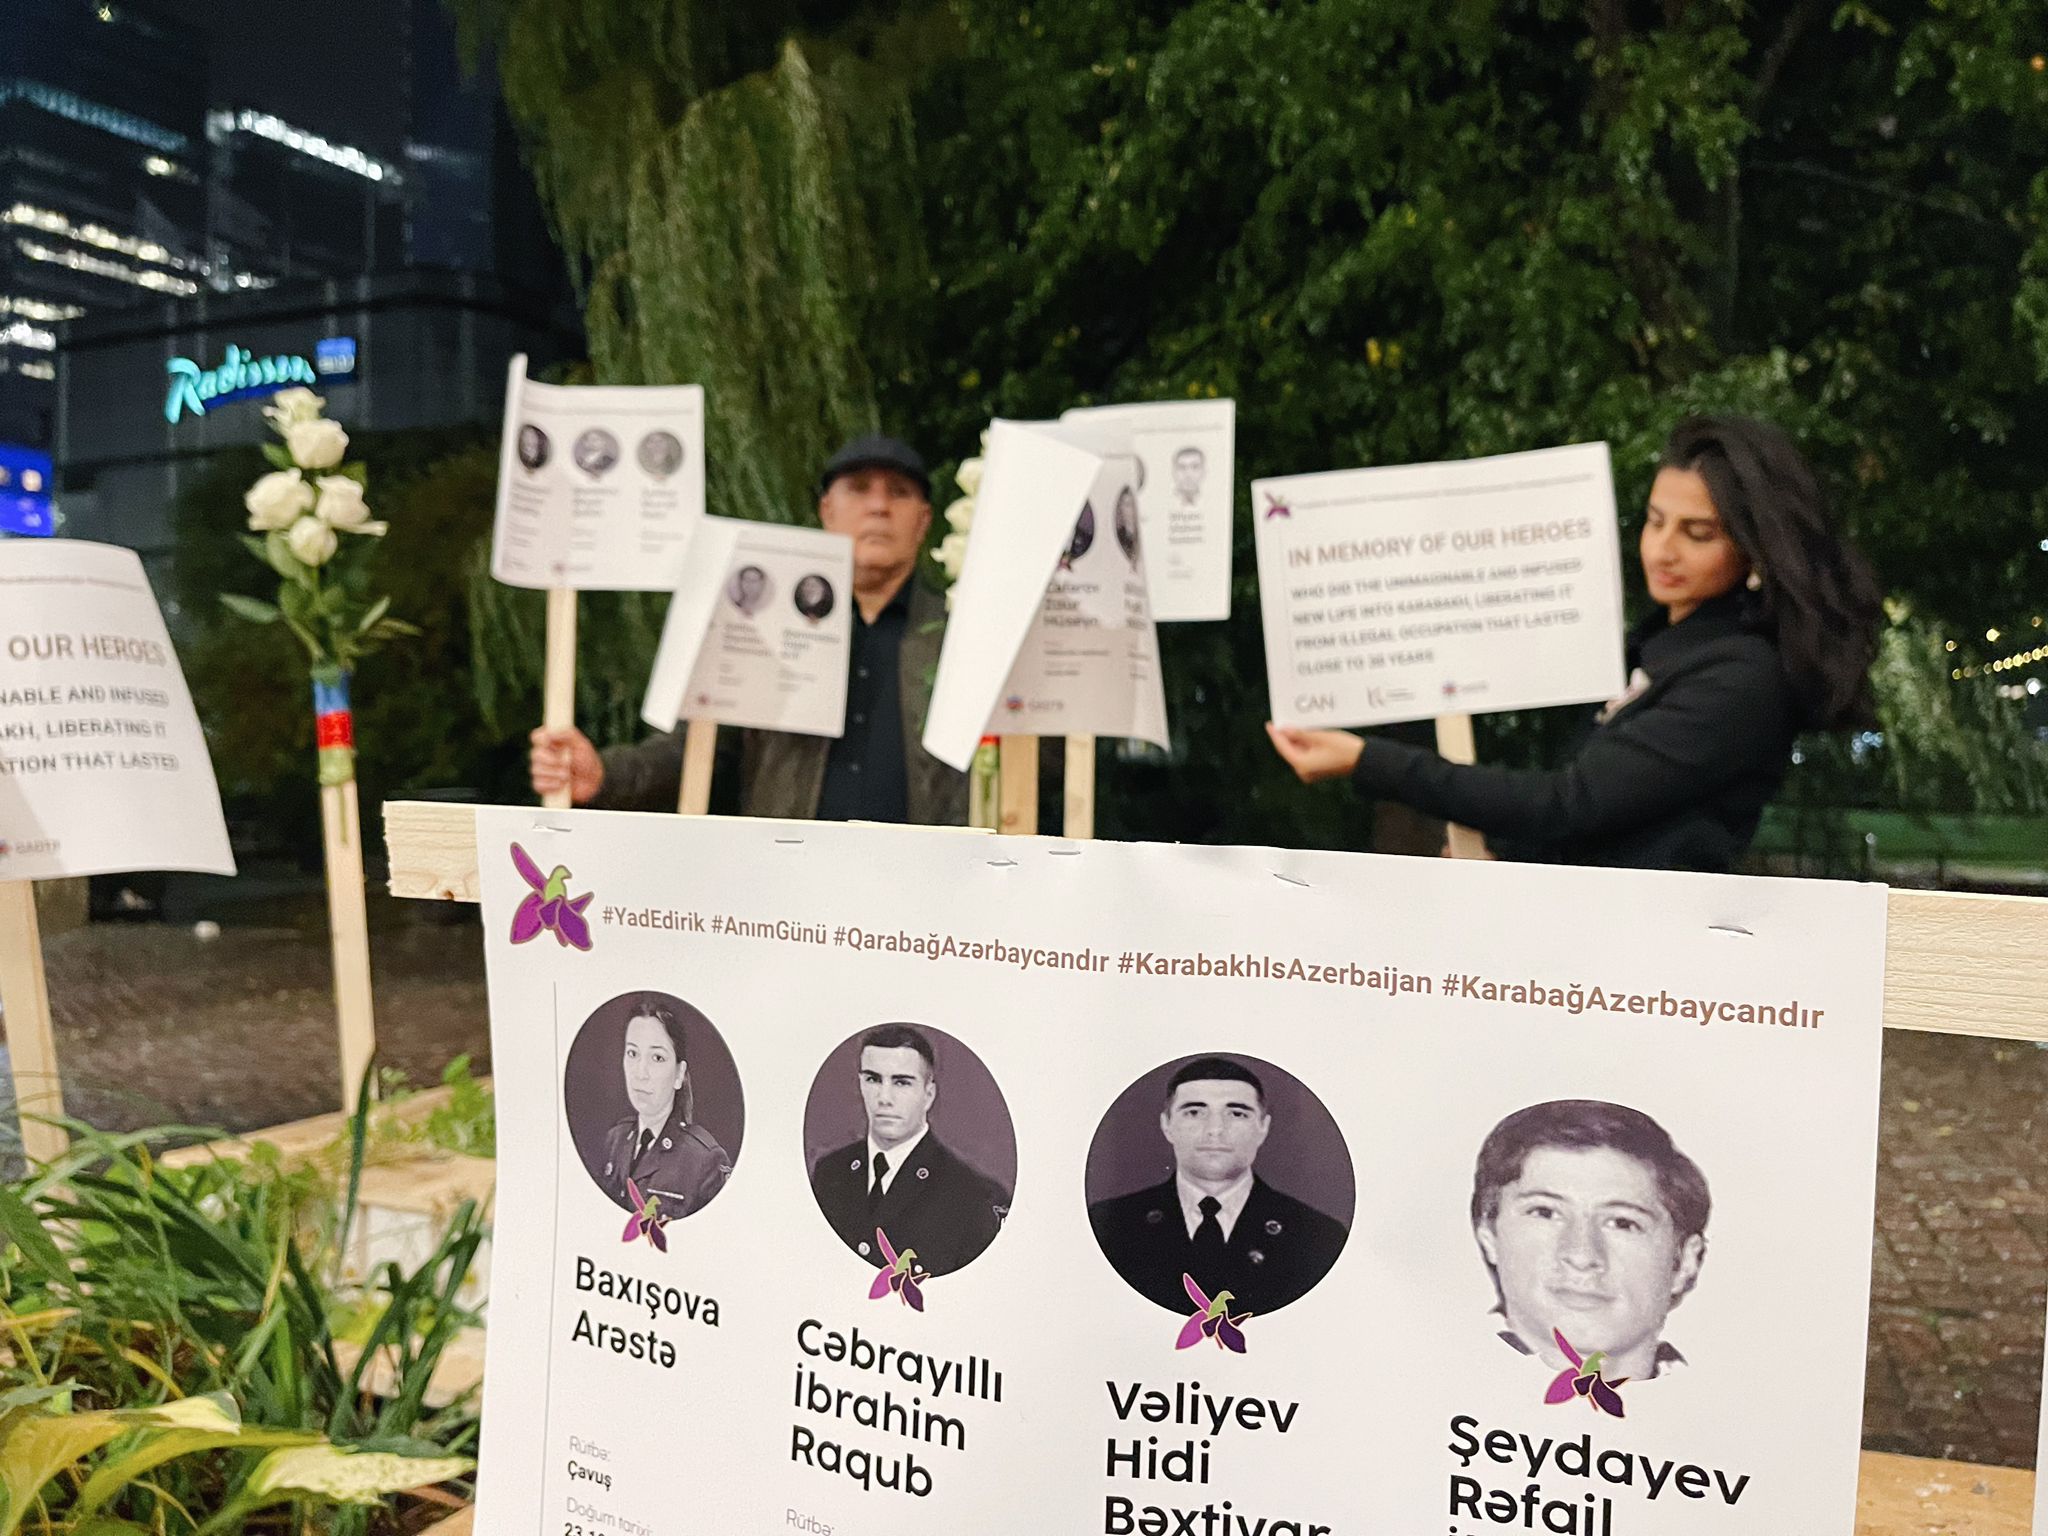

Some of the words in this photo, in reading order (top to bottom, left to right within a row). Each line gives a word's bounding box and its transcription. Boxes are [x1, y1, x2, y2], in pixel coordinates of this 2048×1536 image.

[1288, 547, 1311, 568] IN
[1318, 535, 1415, 564] MEMORY
[1420, 531, 1447, 555] OF
[1452, 528, 1496, 552] OUR
[1501, 517, 1592, 547] HEROES
[9, 634, 73, 661] OUR
[82, 634, 167, 667] HEROES
[68, 685, 105, 703] AND
[0, 721, 40, 742] KH,
[46, 718, 152, 738] LIBERATING
[61, 751, 114, 771] THAT
[602, 905, 706, 934] #YadEdirik
[711, 913, 827, 946] #AnımGünü
[833, 924, 1110, 975] #QarabağAzərbaycandır
[1117, 950, 1433, 996] #KarabakhIsAzerbaijan
[1441, 972, 1824, 1031] #KarabağAzerbaycandır
[576, 1256, 720, 1327] Baxışova
[572, 1309, 677, 1369] Arəstə
[797, 1318, 1003, 1403] Cəbrayıllı
[794, 1363, 966, 1451] İbrahim
[1106, 1380, 1299, 1435] Vəliyev
[567, 1460, 612, 1491] Çavuş
[791, 1424, 933, 1497] Raqub
[1106, 1437, 1211, 1485] Hidi
[1447, 1414, 1750, 1507] Şeydayev
[1449, 1475, 1612, 1536] Rəfail
